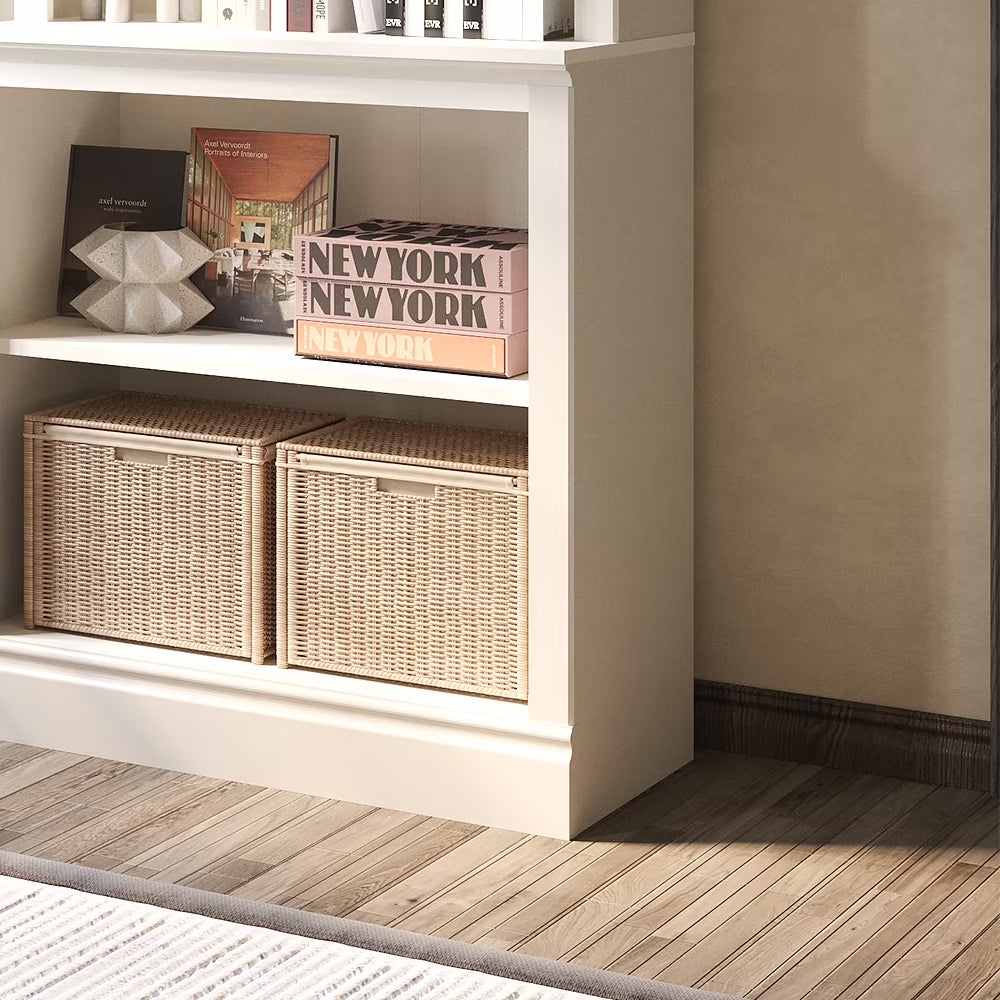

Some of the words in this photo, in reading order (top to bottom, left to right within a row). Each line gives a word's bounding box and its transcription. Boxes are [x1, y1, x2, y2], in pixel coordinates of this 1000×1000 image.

[386, 18, 402, 27] EVR
[425, 19, 441, 29] EVR
[463, 20, 480, 30] EVR
[204, 140, 219, 148] Axel
[220, 140, 251, 149] Vervoordt
[204, 148, 231, 156] Portraits
[232, 149, 240, 157] of
[241, 150, 268, 159] Interiors
[99, 197, 113, 205] axel
[114, 199, 147, 207] vervoordt
[309, 241, 382, 278] NEW
[386, 247, 487, 288] YORK
[310, 281, 383, 319] NEW
[387, 287, 488, 329] YORK
[309, 325, 361, 354] NEW
[362, 330, 434, 362] YORK
